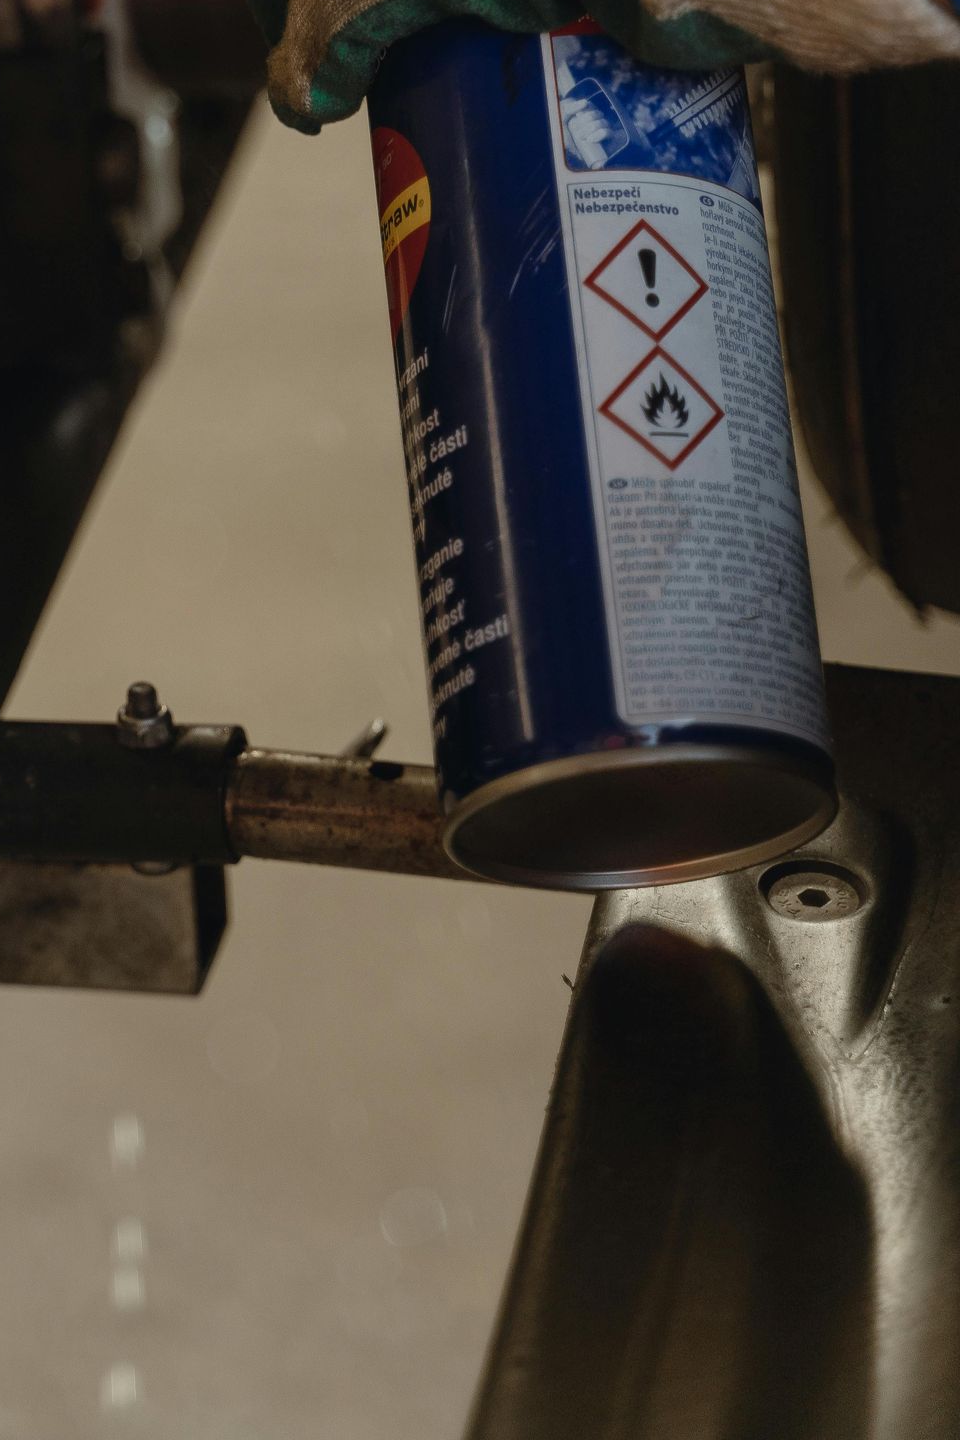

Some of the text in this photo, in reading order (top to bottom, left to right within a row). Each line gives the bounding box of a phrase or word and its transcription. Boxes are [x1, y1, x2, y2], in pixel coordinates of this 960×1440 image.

[573, 186, 641, 201] Nebezpečí
[575, 201, 680, 217] Nebezpečenstvo
[430, 424, 468, 463] části
[419, 537, 464, 581] zganie
[464, 614, 508, 651] časti
